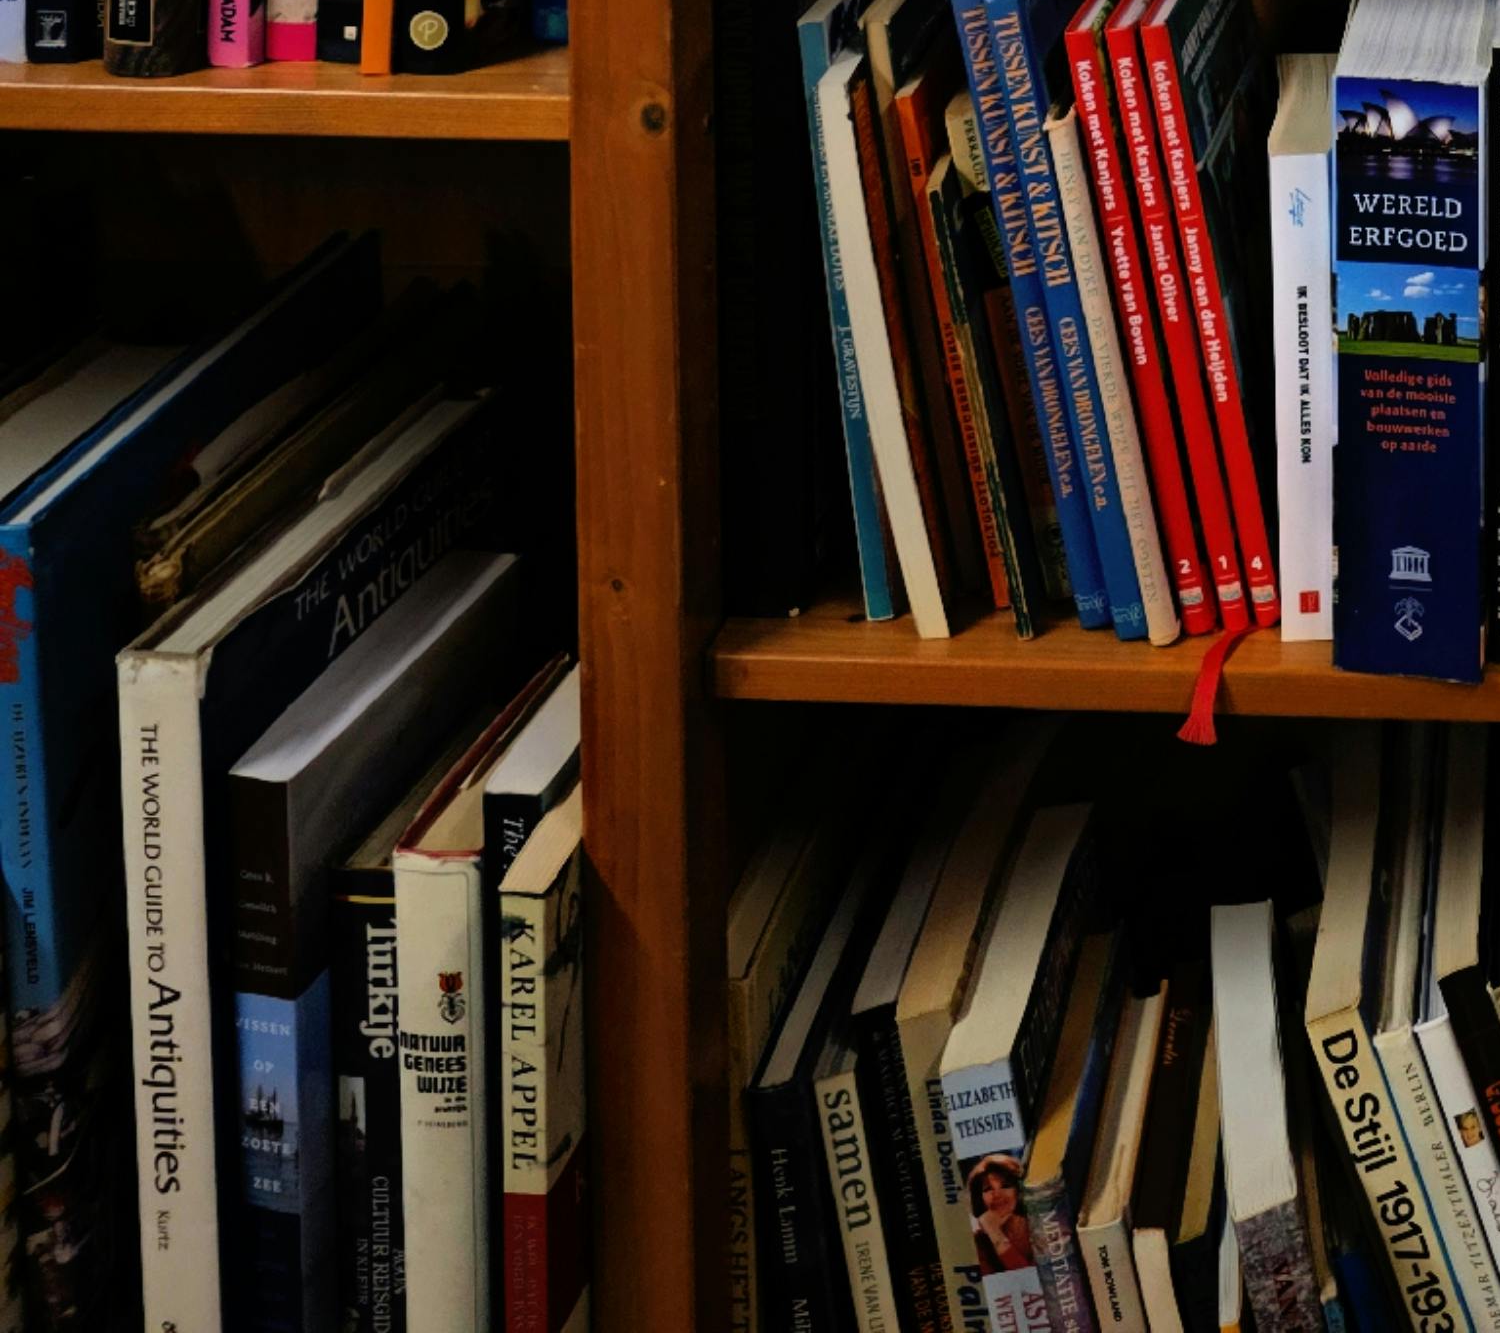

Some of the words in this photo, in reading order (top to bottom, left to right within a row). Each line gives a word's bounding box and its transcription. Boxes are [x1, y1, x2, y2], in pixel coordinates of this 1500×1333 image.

[1348, 226, 1469, 253] ERFGOED
[1352, 193, 1464, 220] WERELD
[141, 723, 161, 763] THE
[142, 769, 162, 865] WORLD
[145, 867, 167, 934] GUIDE
[148, 940, 167, 972] TO
[509, 921, 546, 1045] KAREL
[143, 976, 183, 1195] Antiquities
[512, 1051, 539, 1172] APPEL
[1322, 1030, 1360, 1089] De
[1343, 1091, 1398, 1173] Stijl
[821, 1086, 876, 1231] samen
